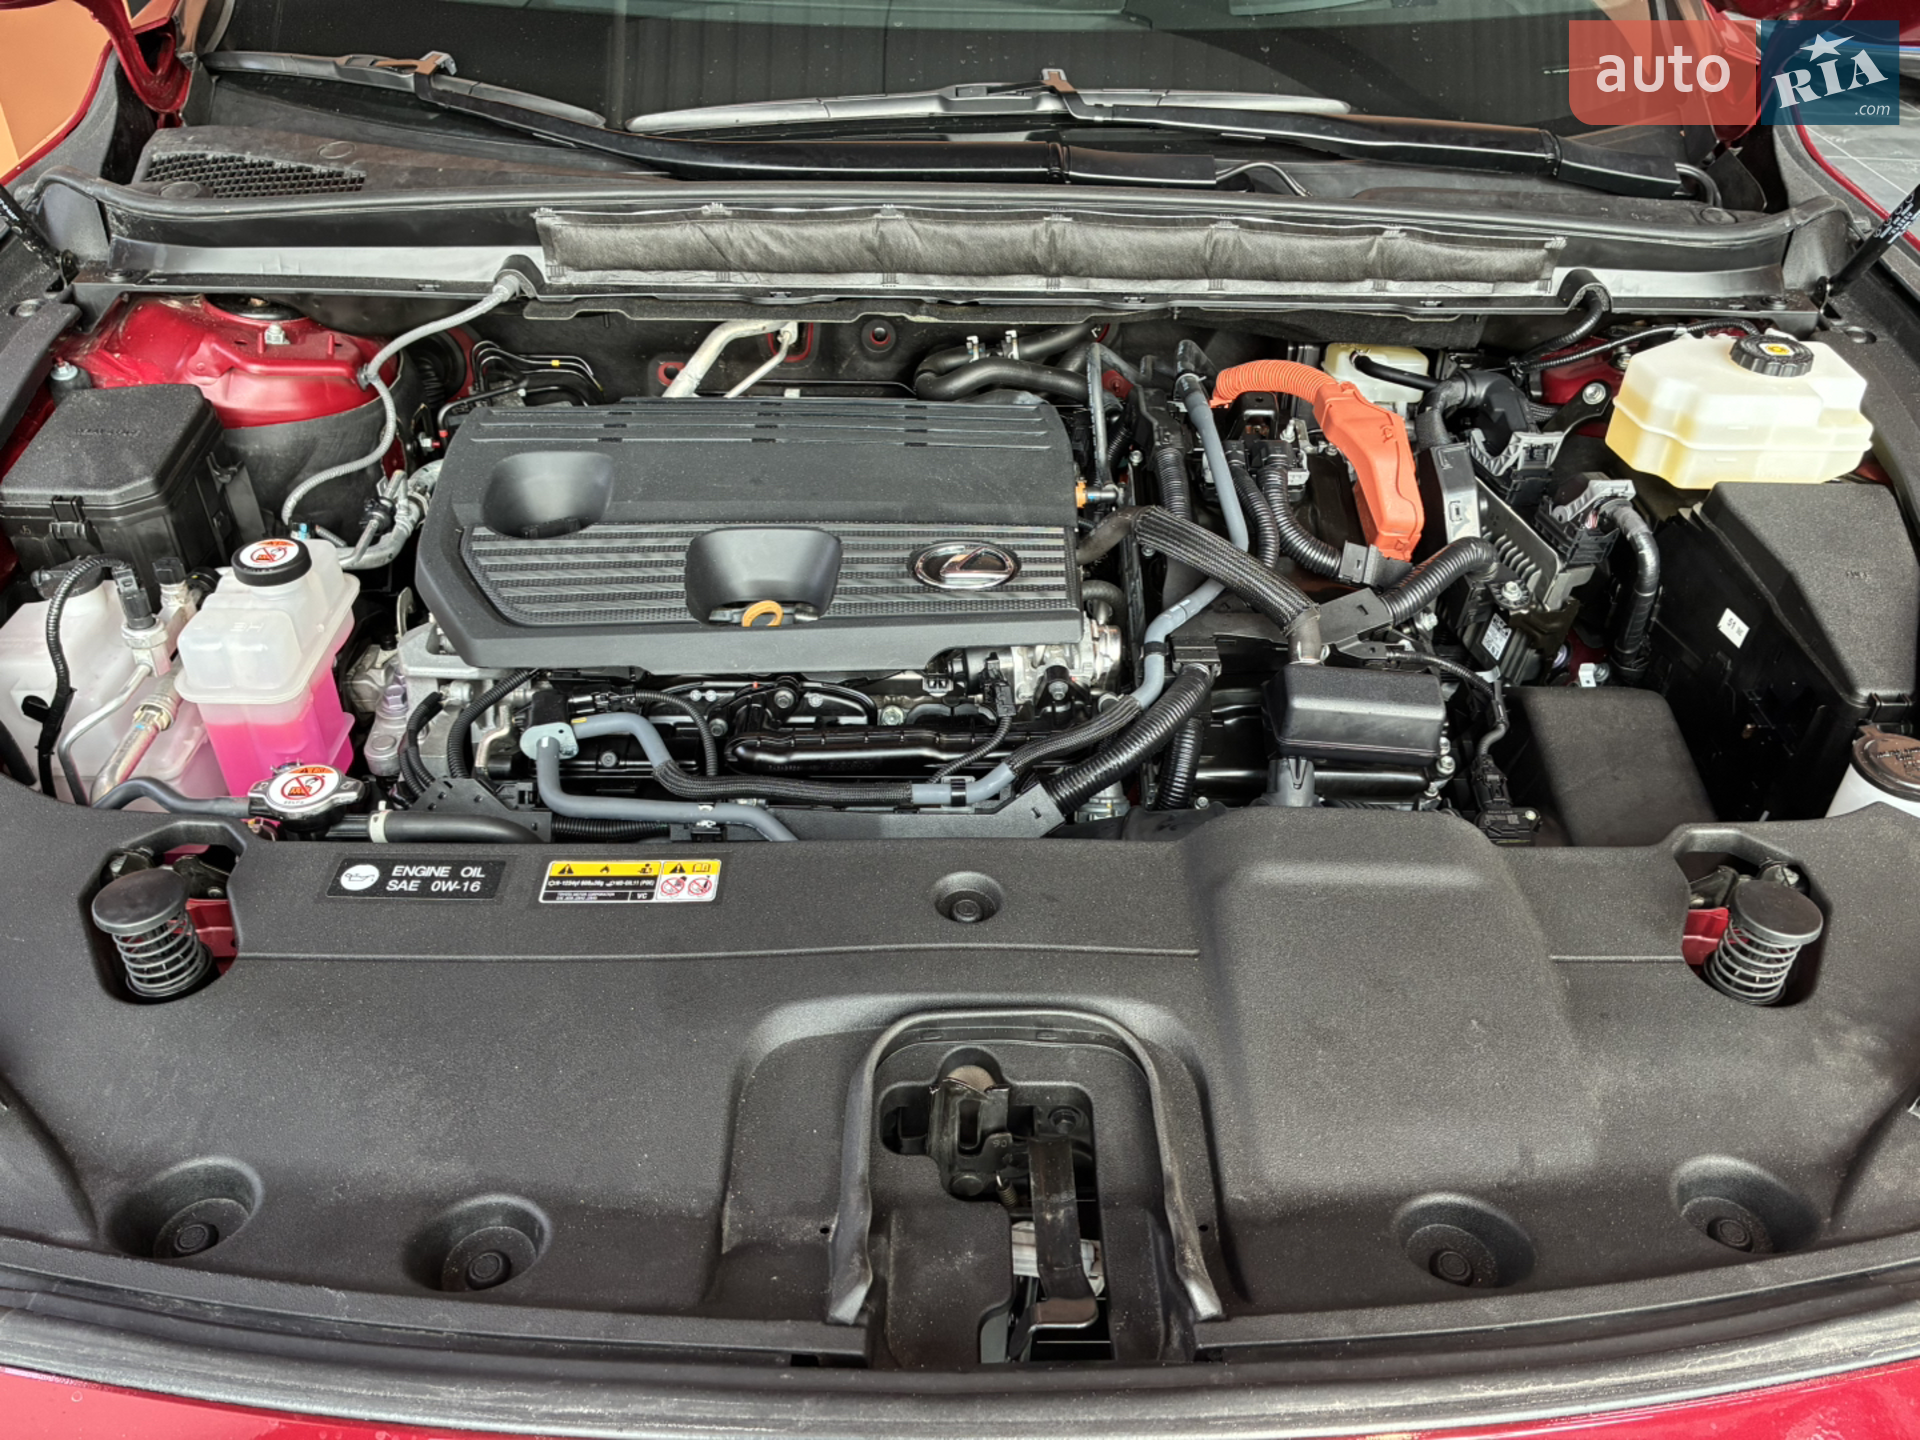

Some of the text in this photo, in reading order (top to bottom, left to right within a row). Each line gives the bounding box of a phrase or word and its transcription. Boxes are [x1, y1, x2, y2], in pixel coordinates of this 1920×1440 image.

[391, 865, 486, 878] ENGINE OIL
[386, 880, 482, 892] SAE 0W-16
